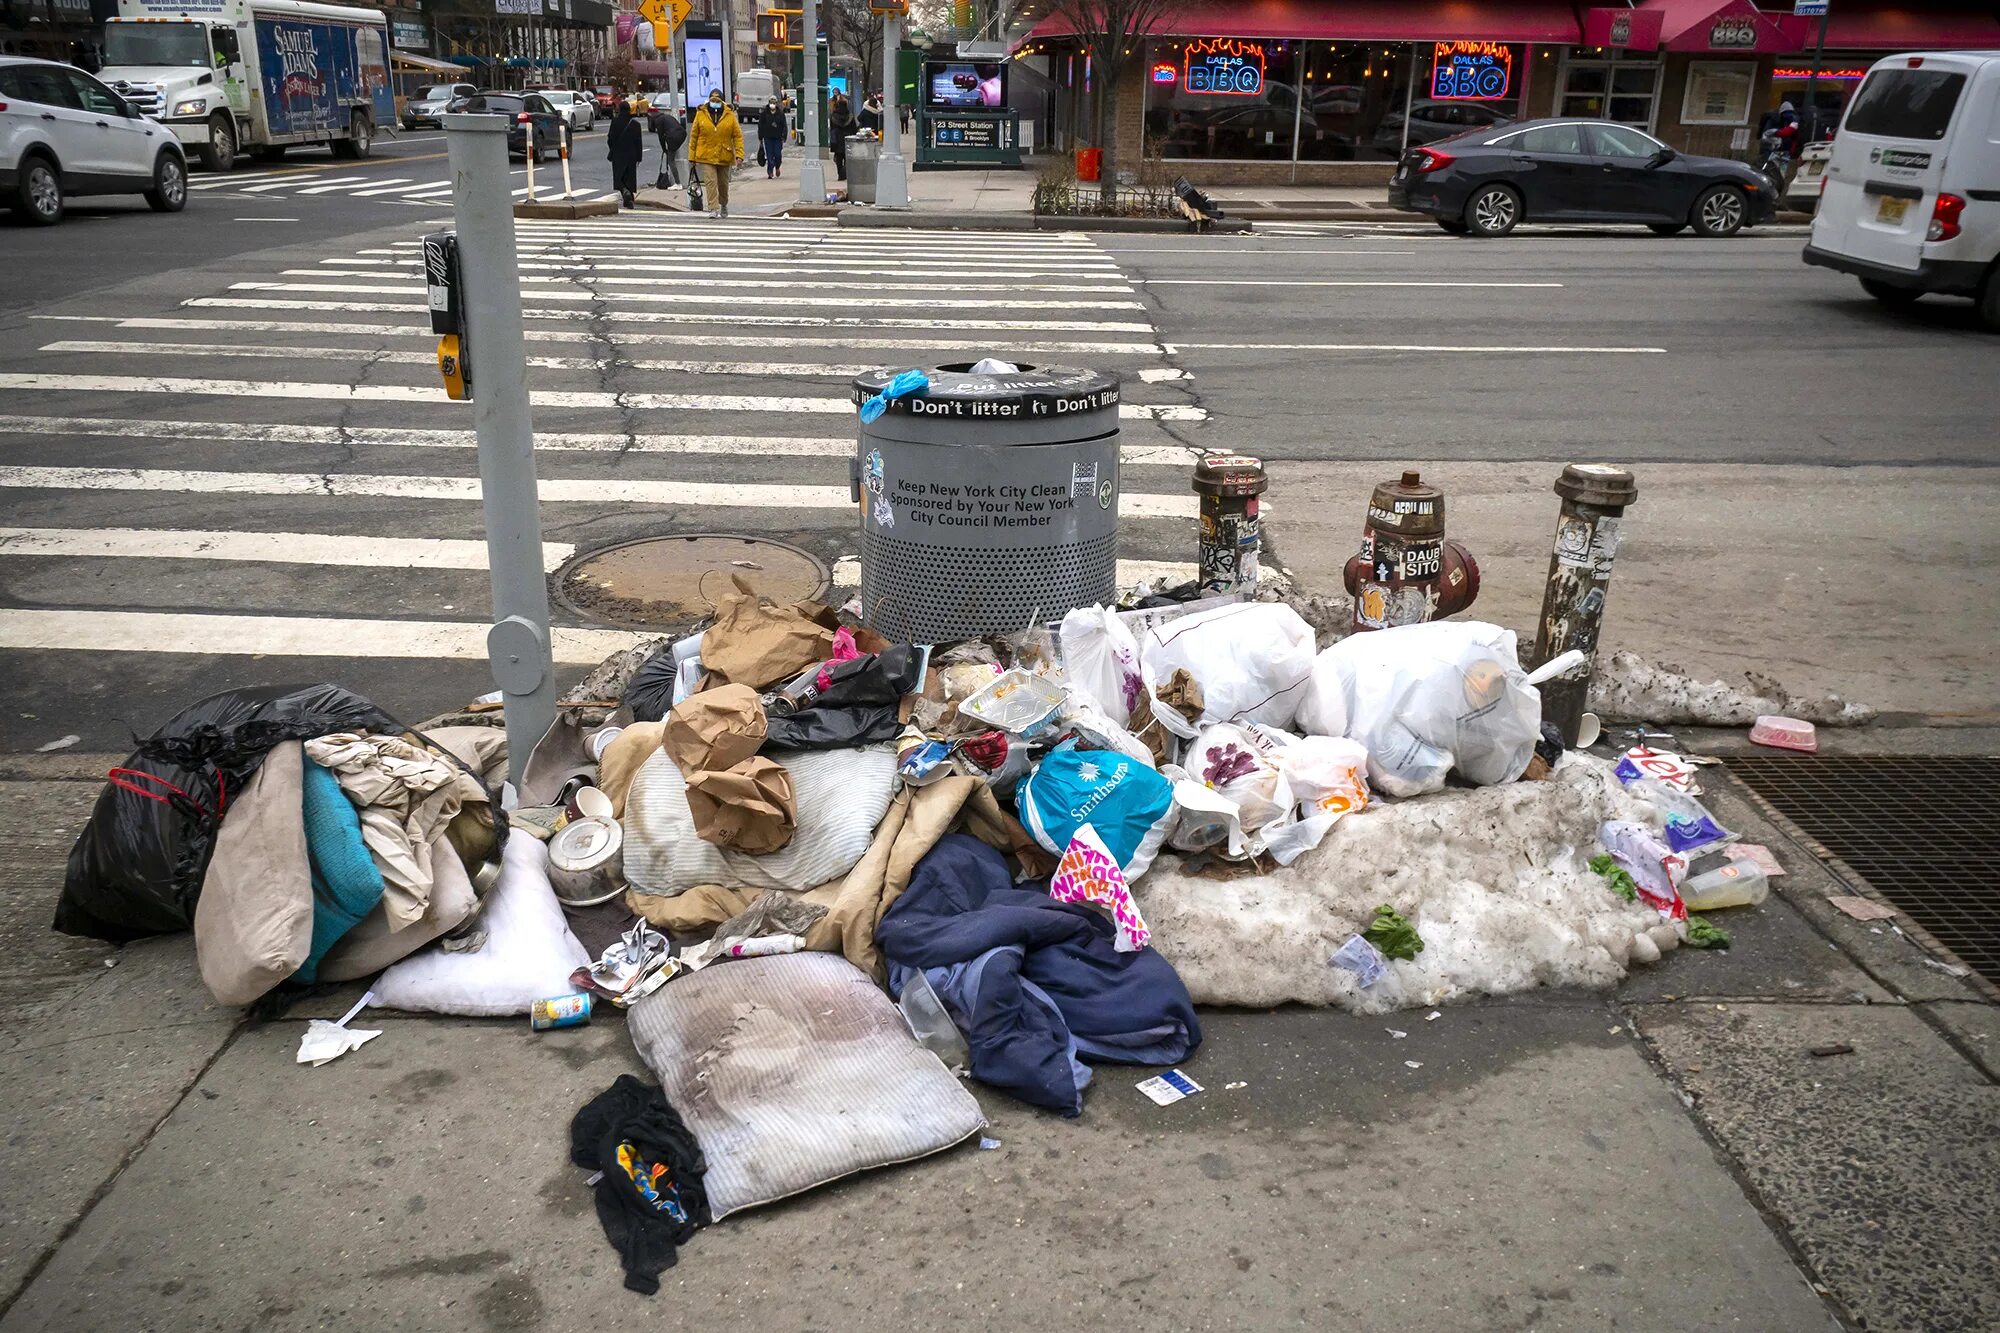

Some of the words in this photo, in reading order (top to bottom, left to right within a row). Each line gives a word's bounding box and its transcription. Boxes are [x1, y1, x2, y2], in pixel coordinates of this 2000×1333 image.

[653, 4, 678, 14] LAE
[274, 25, 318, 56] SAMUEL
[1712, 27, 1754, 43] BBQ
[283, 52, 318, 80] ADAMS
[1453, 56, 1493, 65] DALLAS
[1188, 66, 1260, 93] BBQ
[1434, 66, 1507, 97] BBQ
[912, 399, 962, 415] Don't
[972, 402, 1020, 416] litter
[1056, 395, 1097, 413] Don't
[1101, 391, 1119, 406] litter
[898, 479, 926, 495] Keep
[930, 483, 960, 496] New
[964, 485, 995, 497] York
[1000, 485, 1026, 499] City
[1031, 484, 1066, 496] Clean
[891, 492, 952, 510] Sponsored
[957, 499, 974, 514] by
[978, 500, 1010, 513] Your
[1014, 500, 1046, 511] New
[1049, 496, 1074, 510] York
[910, 510, 934, 525] City
[938, 513, 988, 527] Council
[993, 516, 1052, 527] Member
[1407, 547, 1440, 562] DAUB
[1407, 560, 1440, 577] SITO
